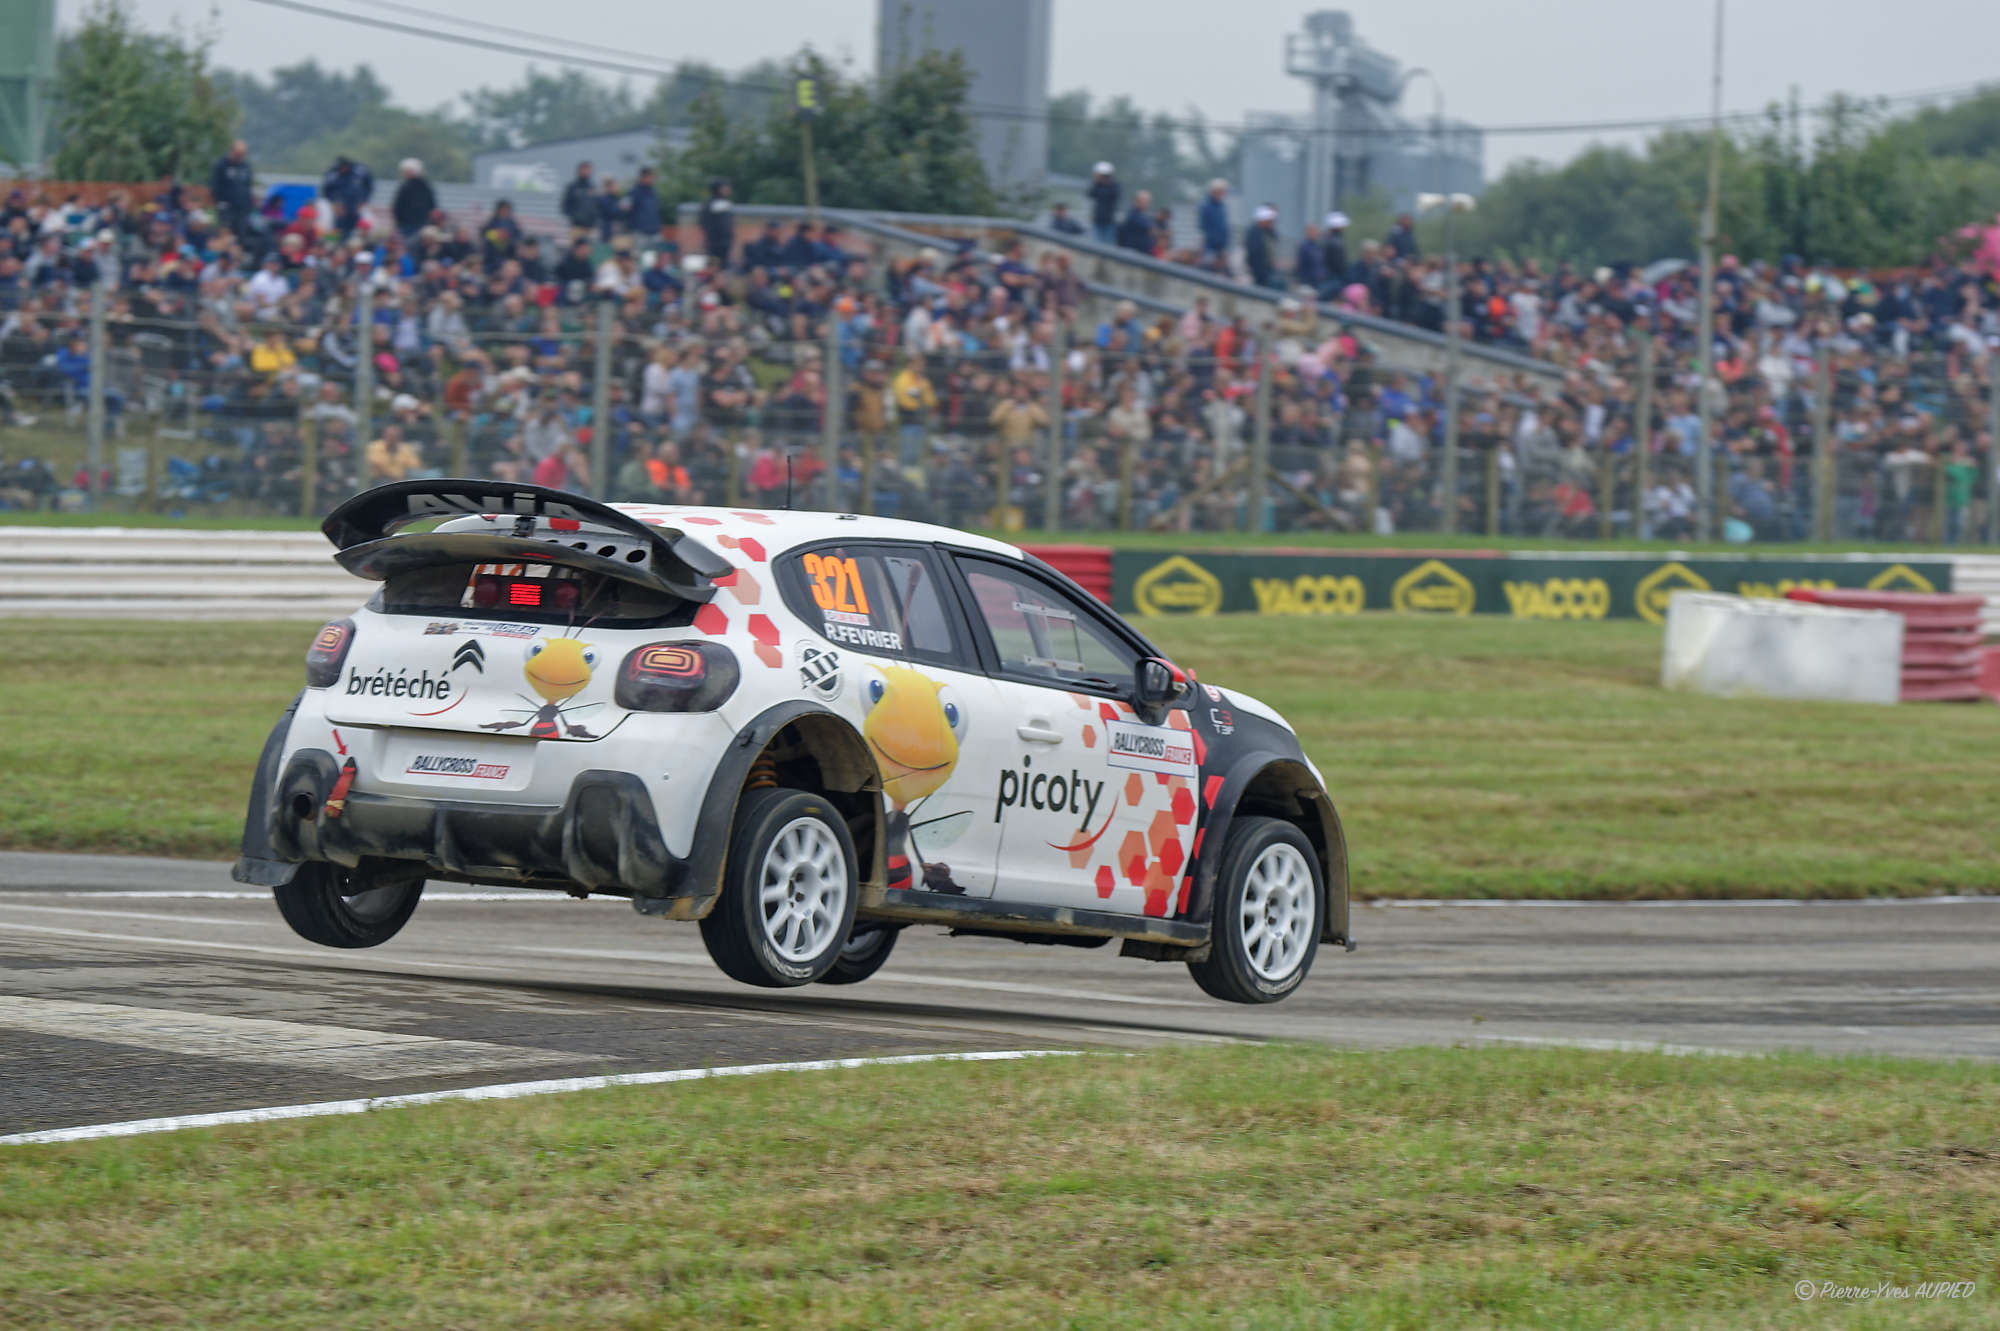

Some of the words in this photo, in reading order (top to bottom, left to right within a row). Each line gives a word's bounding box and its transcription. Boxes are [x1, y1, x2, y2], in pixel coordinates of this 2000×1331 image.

[803, 553, 870, 614] 321
[1252, 575, 1365, 617] YACCO
[1503, 577, 1610, 620] YACCO
[345, 666, 450, 700] brétéché
[411, 755, 477, 773] RALLYCROSS
[1114, 732, 1165, 756] RALLYCROSS
[994, 754, 1104, 833] picoty
